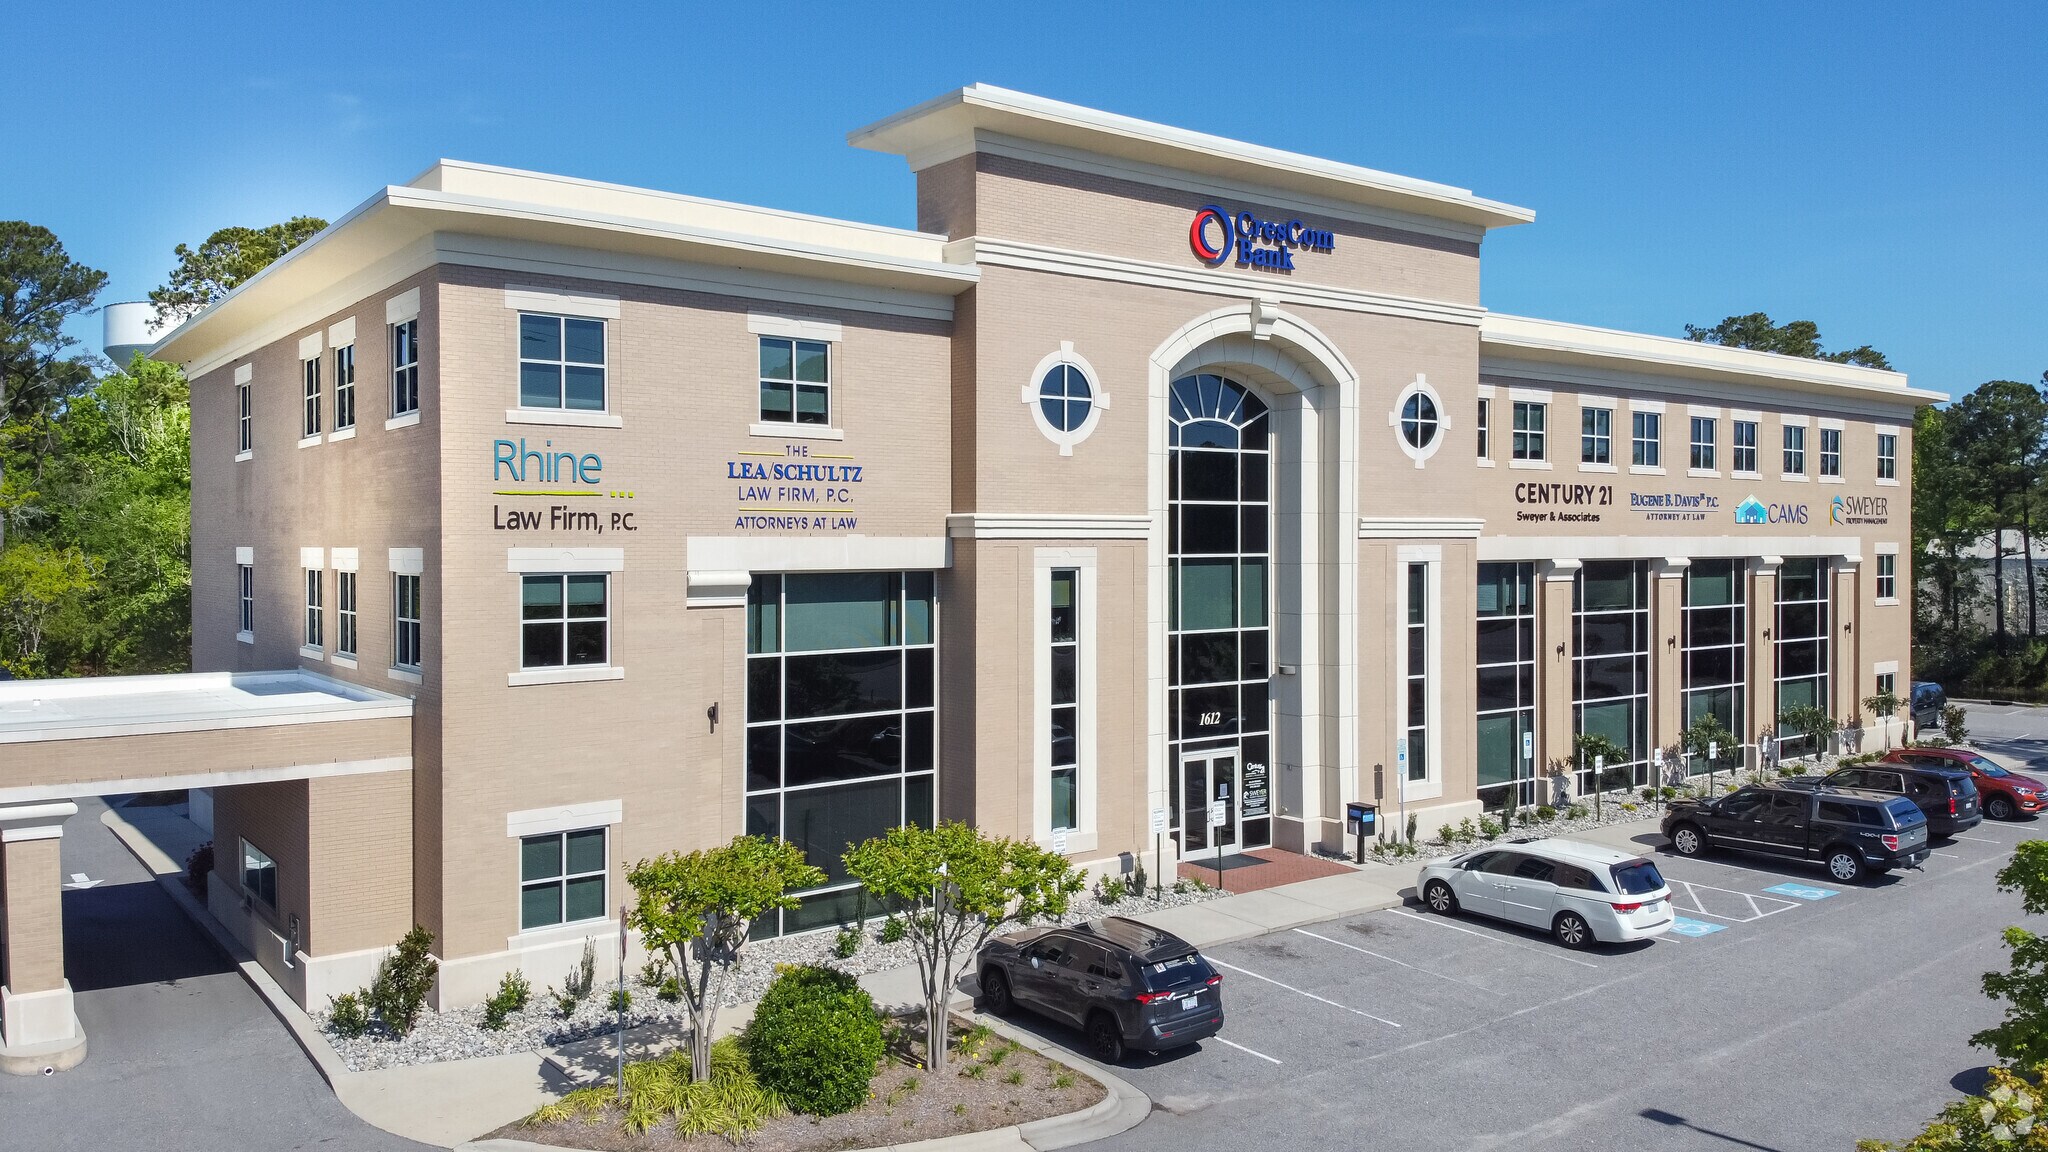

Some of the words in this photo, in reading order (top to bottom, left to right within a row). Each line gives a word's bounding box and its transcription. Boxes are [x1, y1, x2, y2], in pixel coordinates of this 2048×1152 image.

[1237, 211, 1335, 249] CresCom
[1237, 238, 1295, 270] Bank
[786, 445, 808, 457] THE
[494, 438, 602, 484] Rhine
[727, 462, 863, 482] LEA/SCHULTZ
[738, 486, 772, 501] LAW
[778, 487, 819, 503] FIRM,
[826, 488, 854, 503] P.C.
[1515, 483, 1595, 505] CENTURY
[1599, 485, 1612, 505] 21
[1630, 493, 1664, 506] EUGENE
[1665, 493, 1673, 507] B.
[1768, 504, 1808, 524] CAMS
[1846, 496, 1888, 515] SWEYER
[494, 505, 542, 530] Law
[551, 505, 603, 534] Firm,
[612, 512, 637, 531] P.C.
[734, 516, 808, 530] ATTORNEYS
[812, 517, 827, 530] AT
[831, 517, 858, 530] LAW
[1516, 511, 1548, 524] Sweyer
[1549, 511, 1556, 522] &
[1558, 511, 1600, 523] Associates
[1199, 712, 1221, 726] 1612
